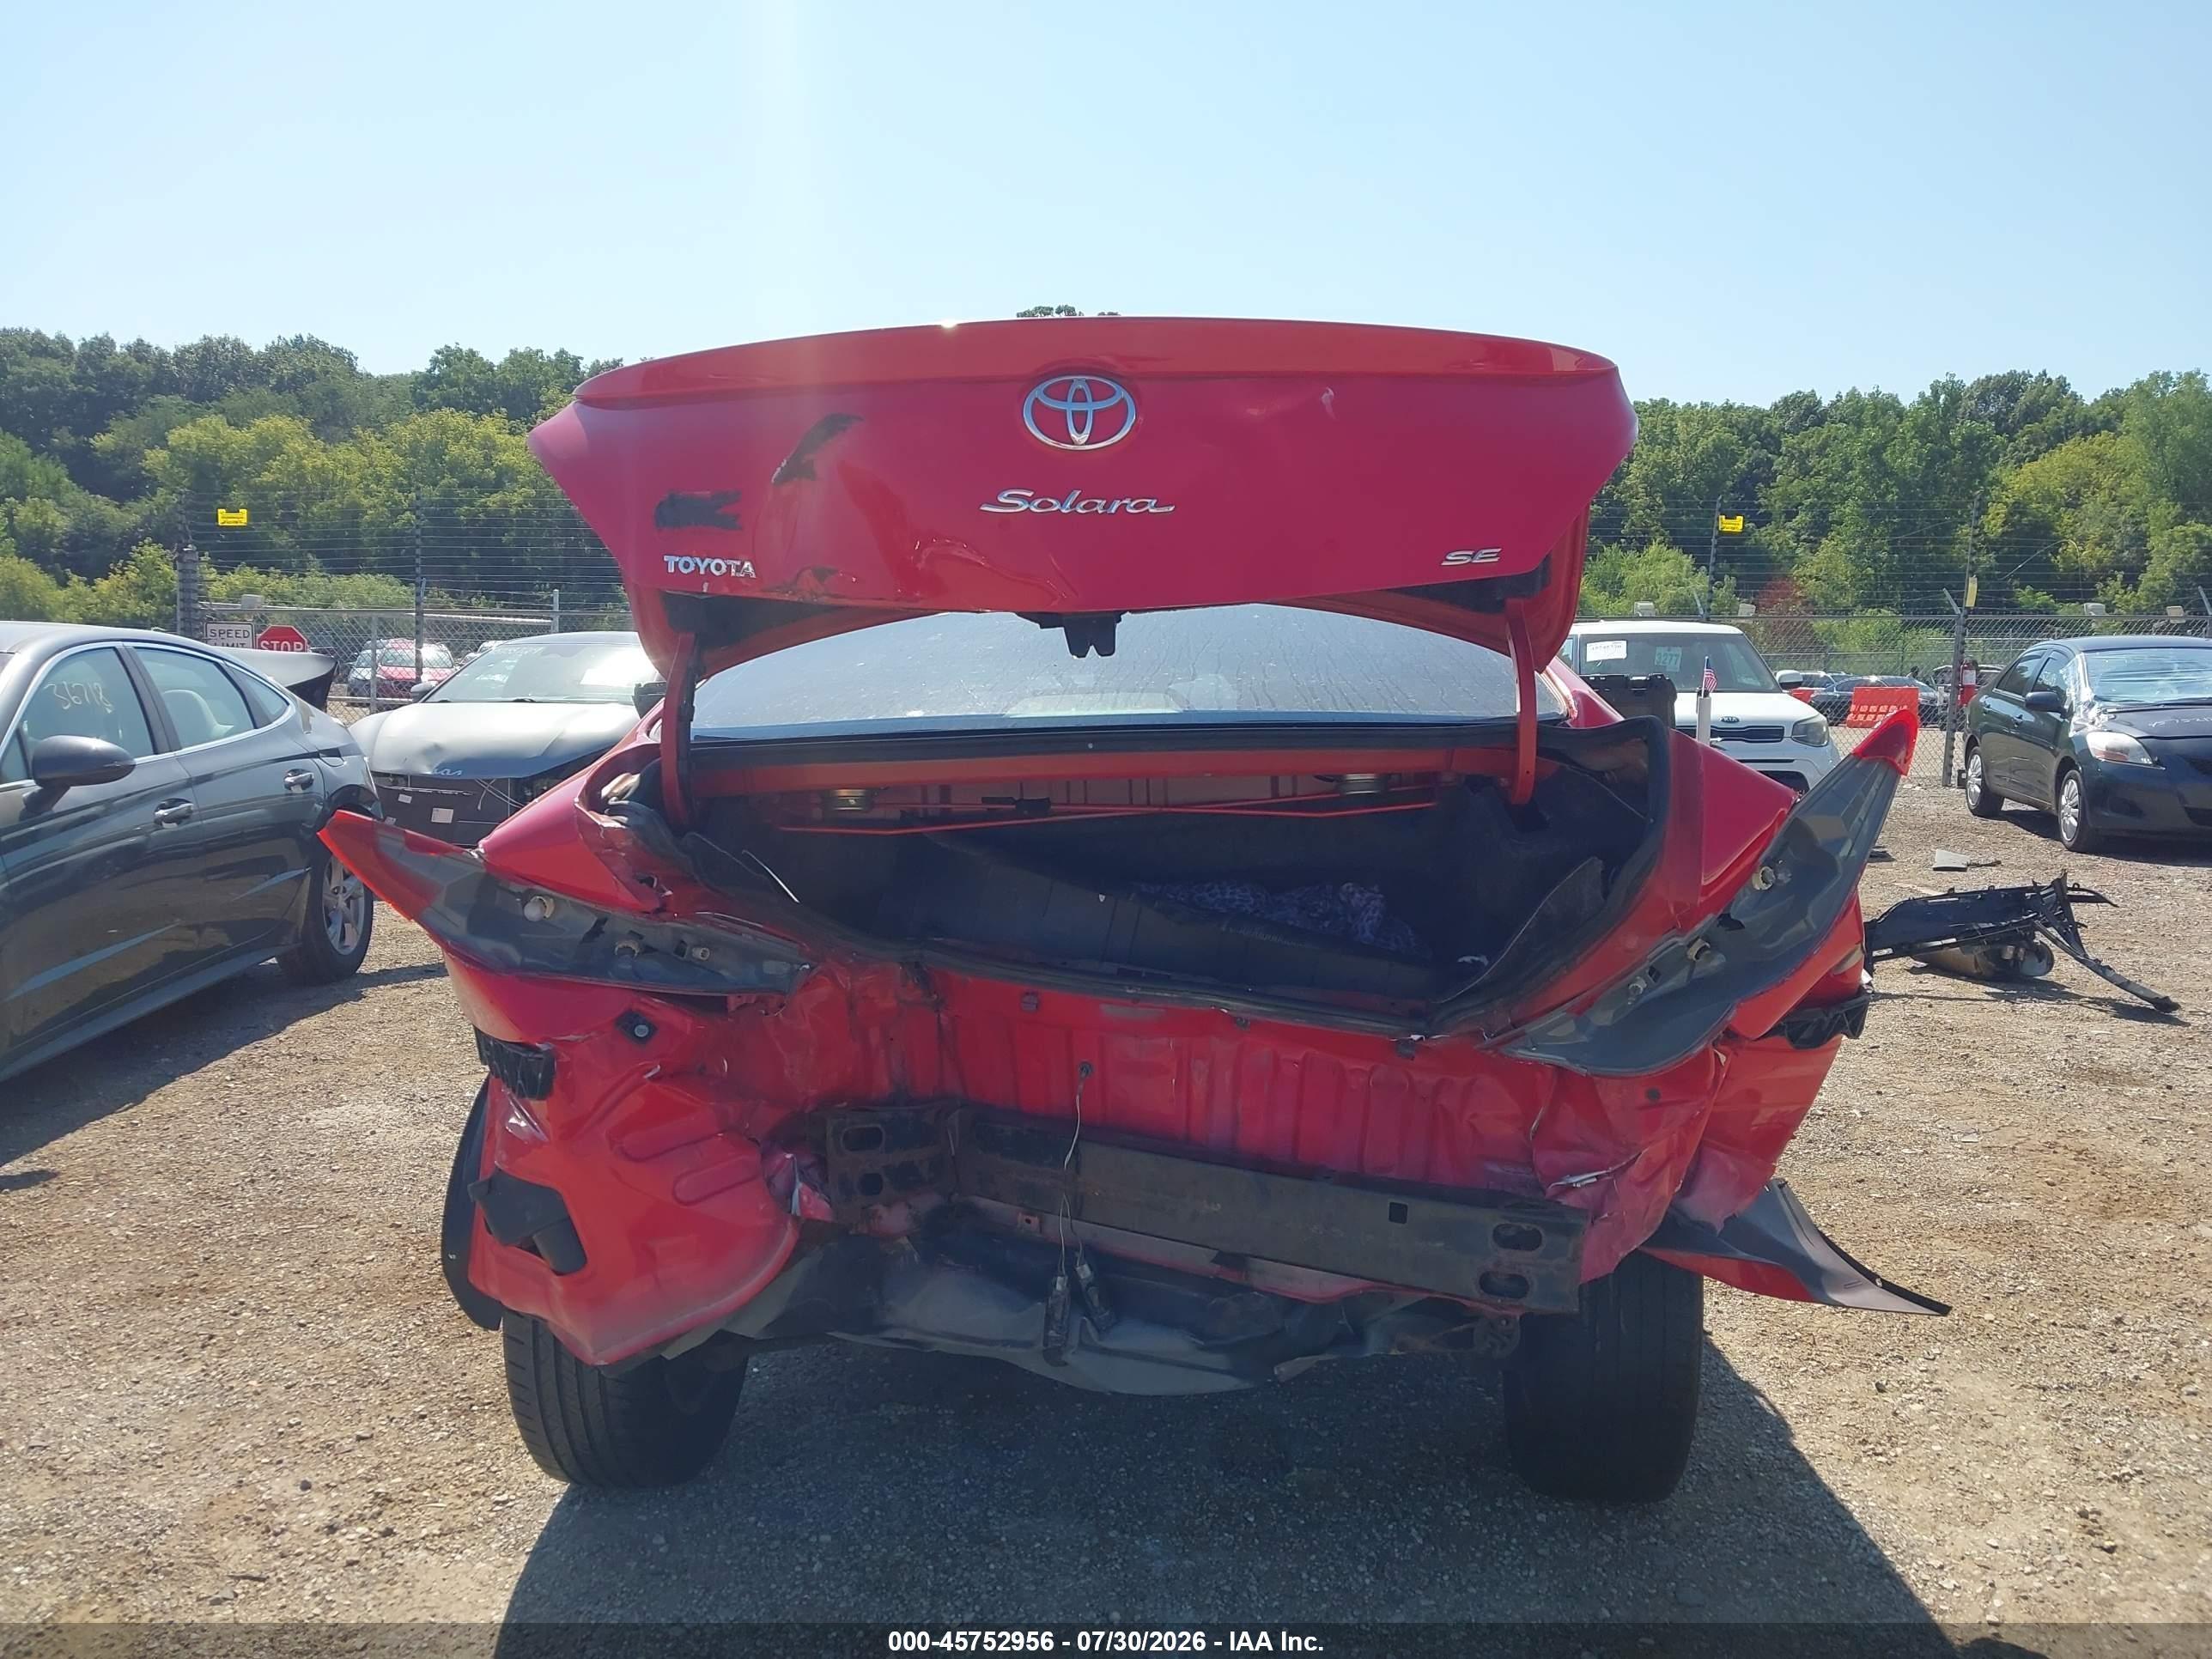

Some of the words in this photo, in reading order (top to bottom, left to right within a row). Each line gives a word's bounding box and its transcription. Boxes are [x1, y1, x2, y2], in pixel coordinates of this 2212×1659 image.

[980, 489, 1175, 514] Solara
[1441, 548, 1503, 566] SE
[664, 555, 756, 578] TOYOTA
[210, 629, 251, 639] SPEED
[260, 640, 303, 652] STOP
